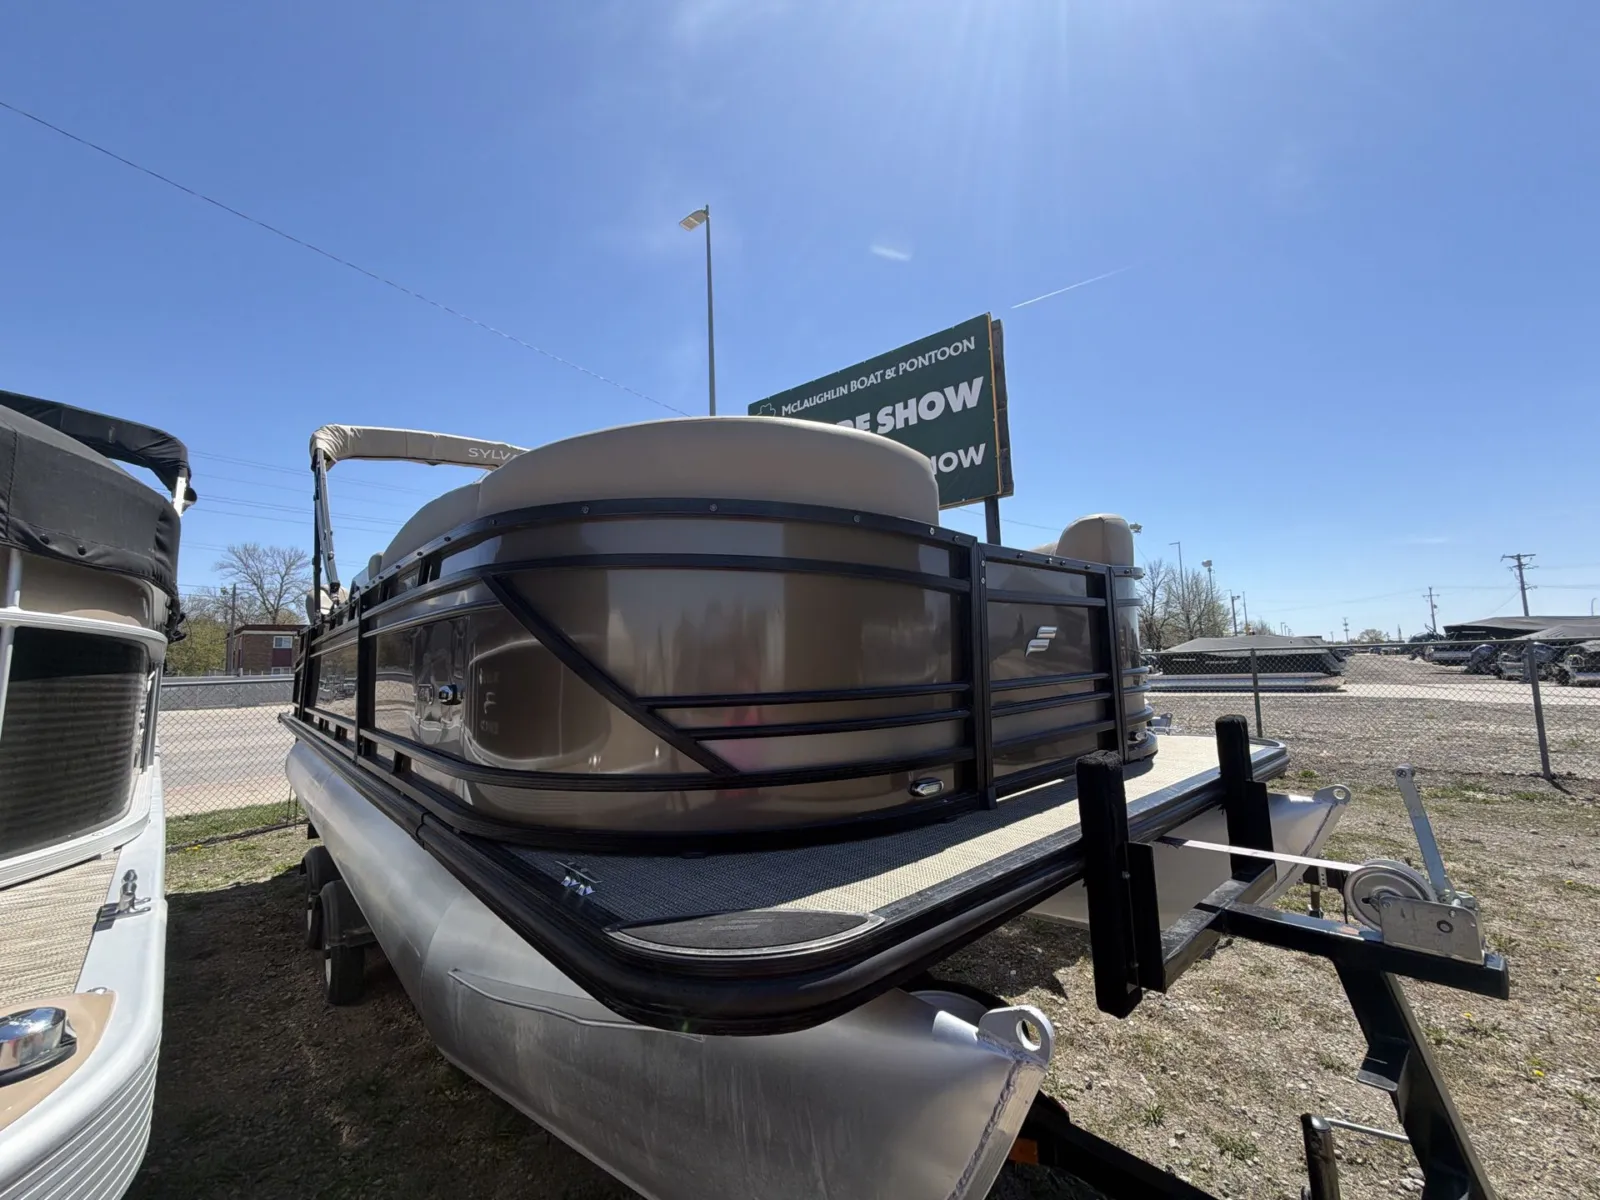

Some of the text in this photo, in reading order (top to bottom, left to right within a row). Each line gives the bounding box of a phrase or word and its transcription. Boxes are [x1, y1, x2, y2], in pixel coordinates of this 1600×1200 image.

[850, 370, 883, 393] BOAT
[885, 367, 897, 380] &
[899, 336, 976, 375] PONTOON
[876, 376, 984, 434] SHOW
[468, 447, 518, 461] SYLV
